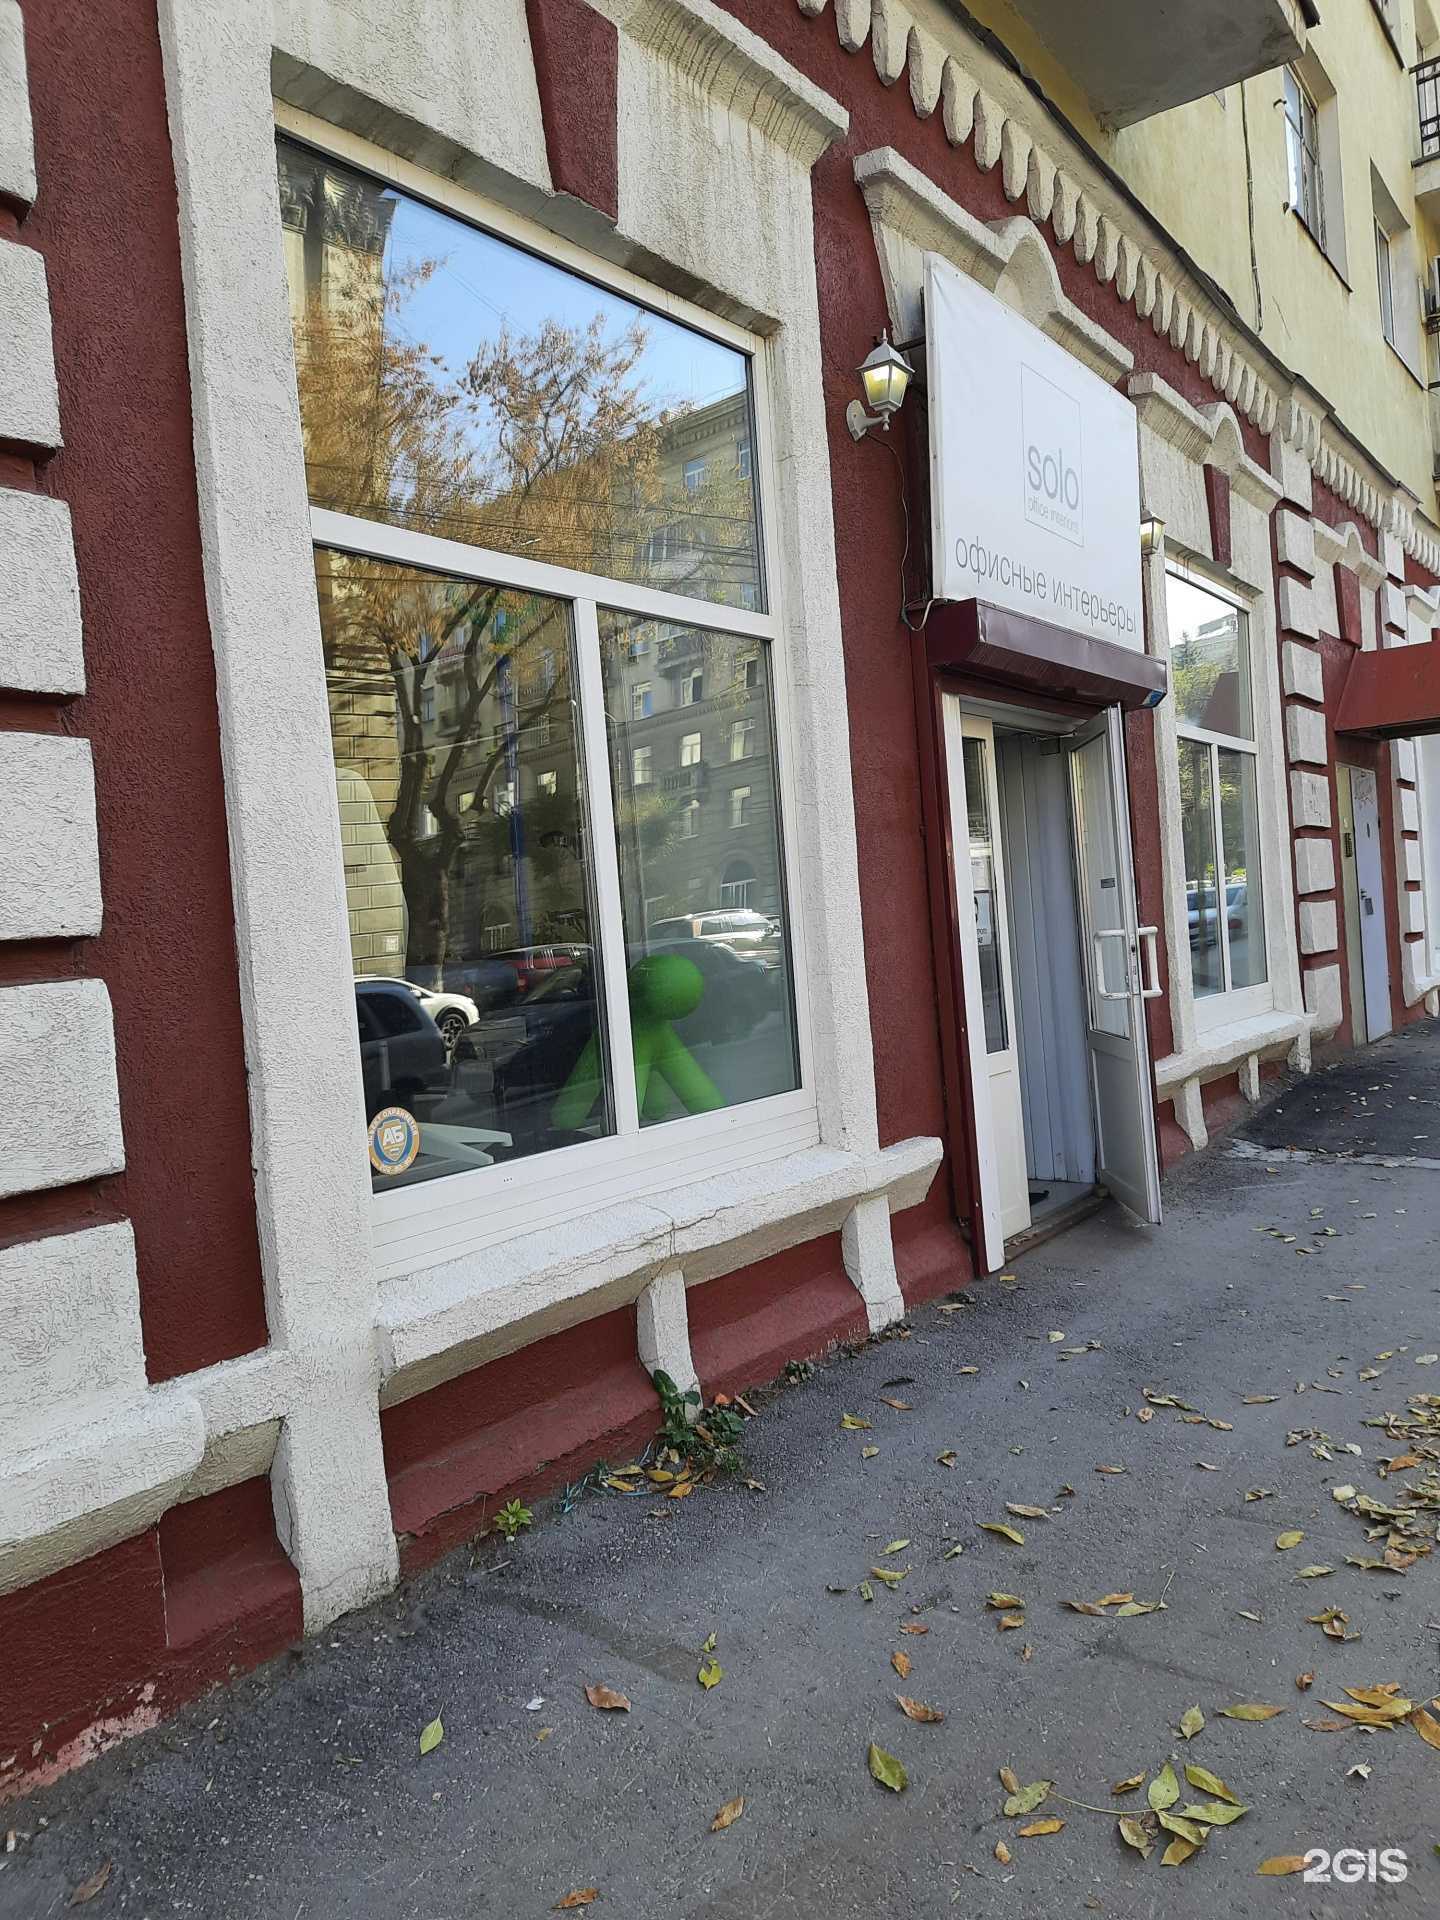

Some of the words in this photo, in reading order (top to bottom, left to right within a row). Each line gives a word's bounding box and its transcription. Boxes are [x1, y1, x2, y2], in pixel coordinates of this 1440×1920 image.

[1028, 445, 1079, 510] solo
[955, 535, 1048, 600] офисные
[1052, 575, 1137, 636] интерьеры
